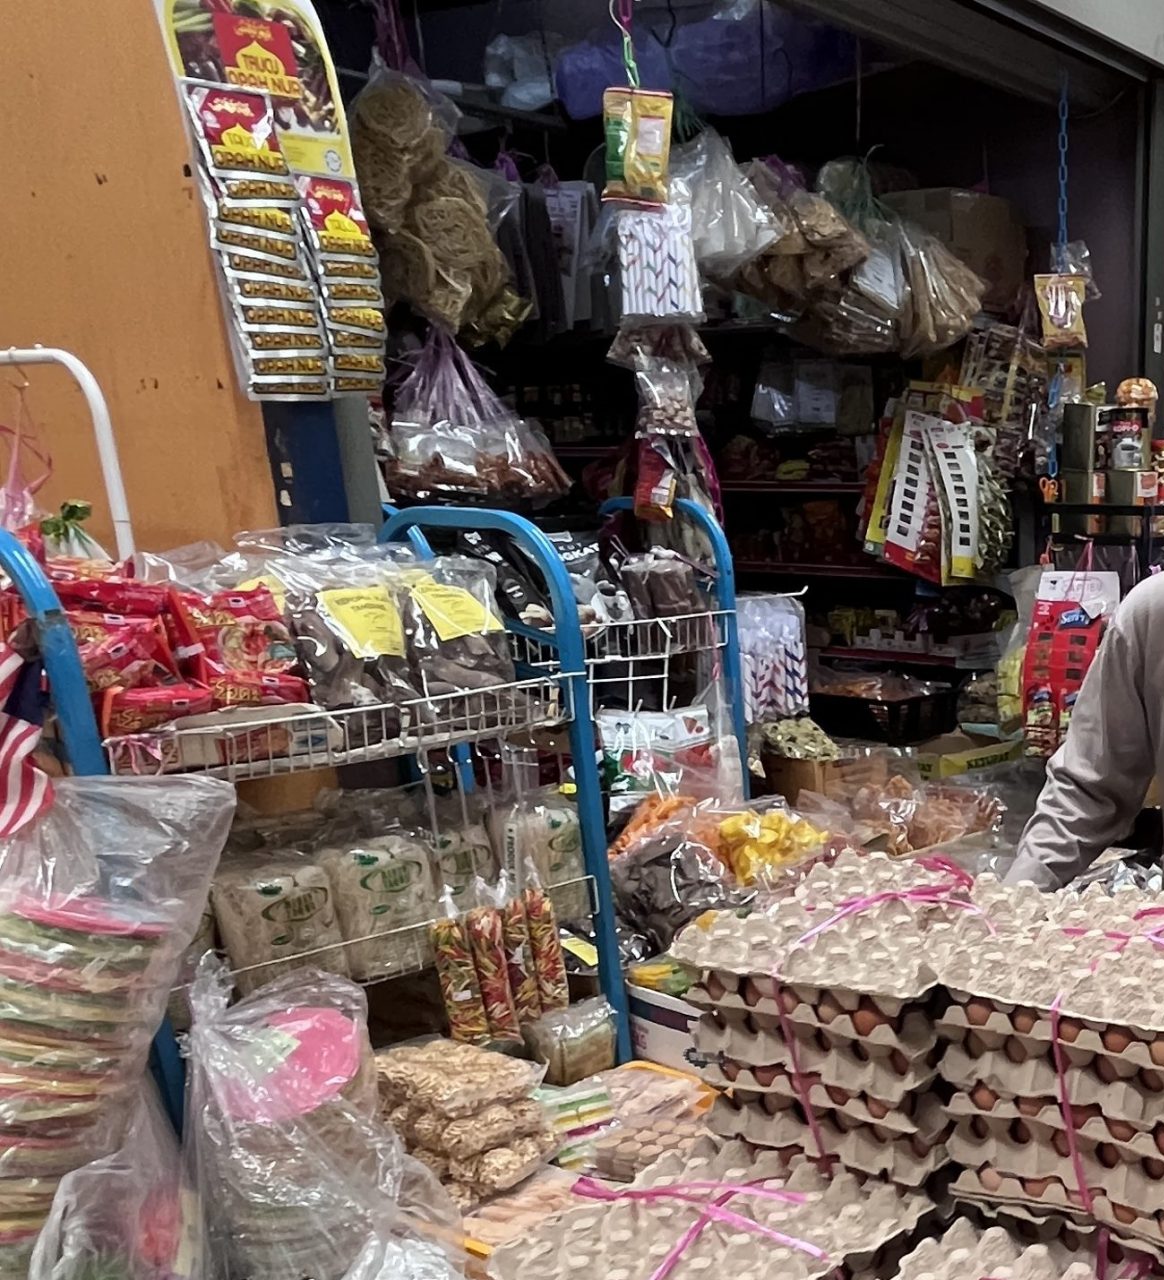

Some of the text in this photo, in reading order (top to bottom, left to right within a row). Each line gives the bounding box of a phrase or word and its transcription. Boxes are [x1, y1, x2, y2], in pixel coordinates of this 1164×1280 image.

[228, 70, 267, 88] OPAH
[215, 151, 253, 167] OPAH
[244, 283, 287, 297] OPAH
[247, 307, 289, 322] OPAH
[254, 333, 295, 347] OPAH
[258, 360, 298, 374] OPAH
